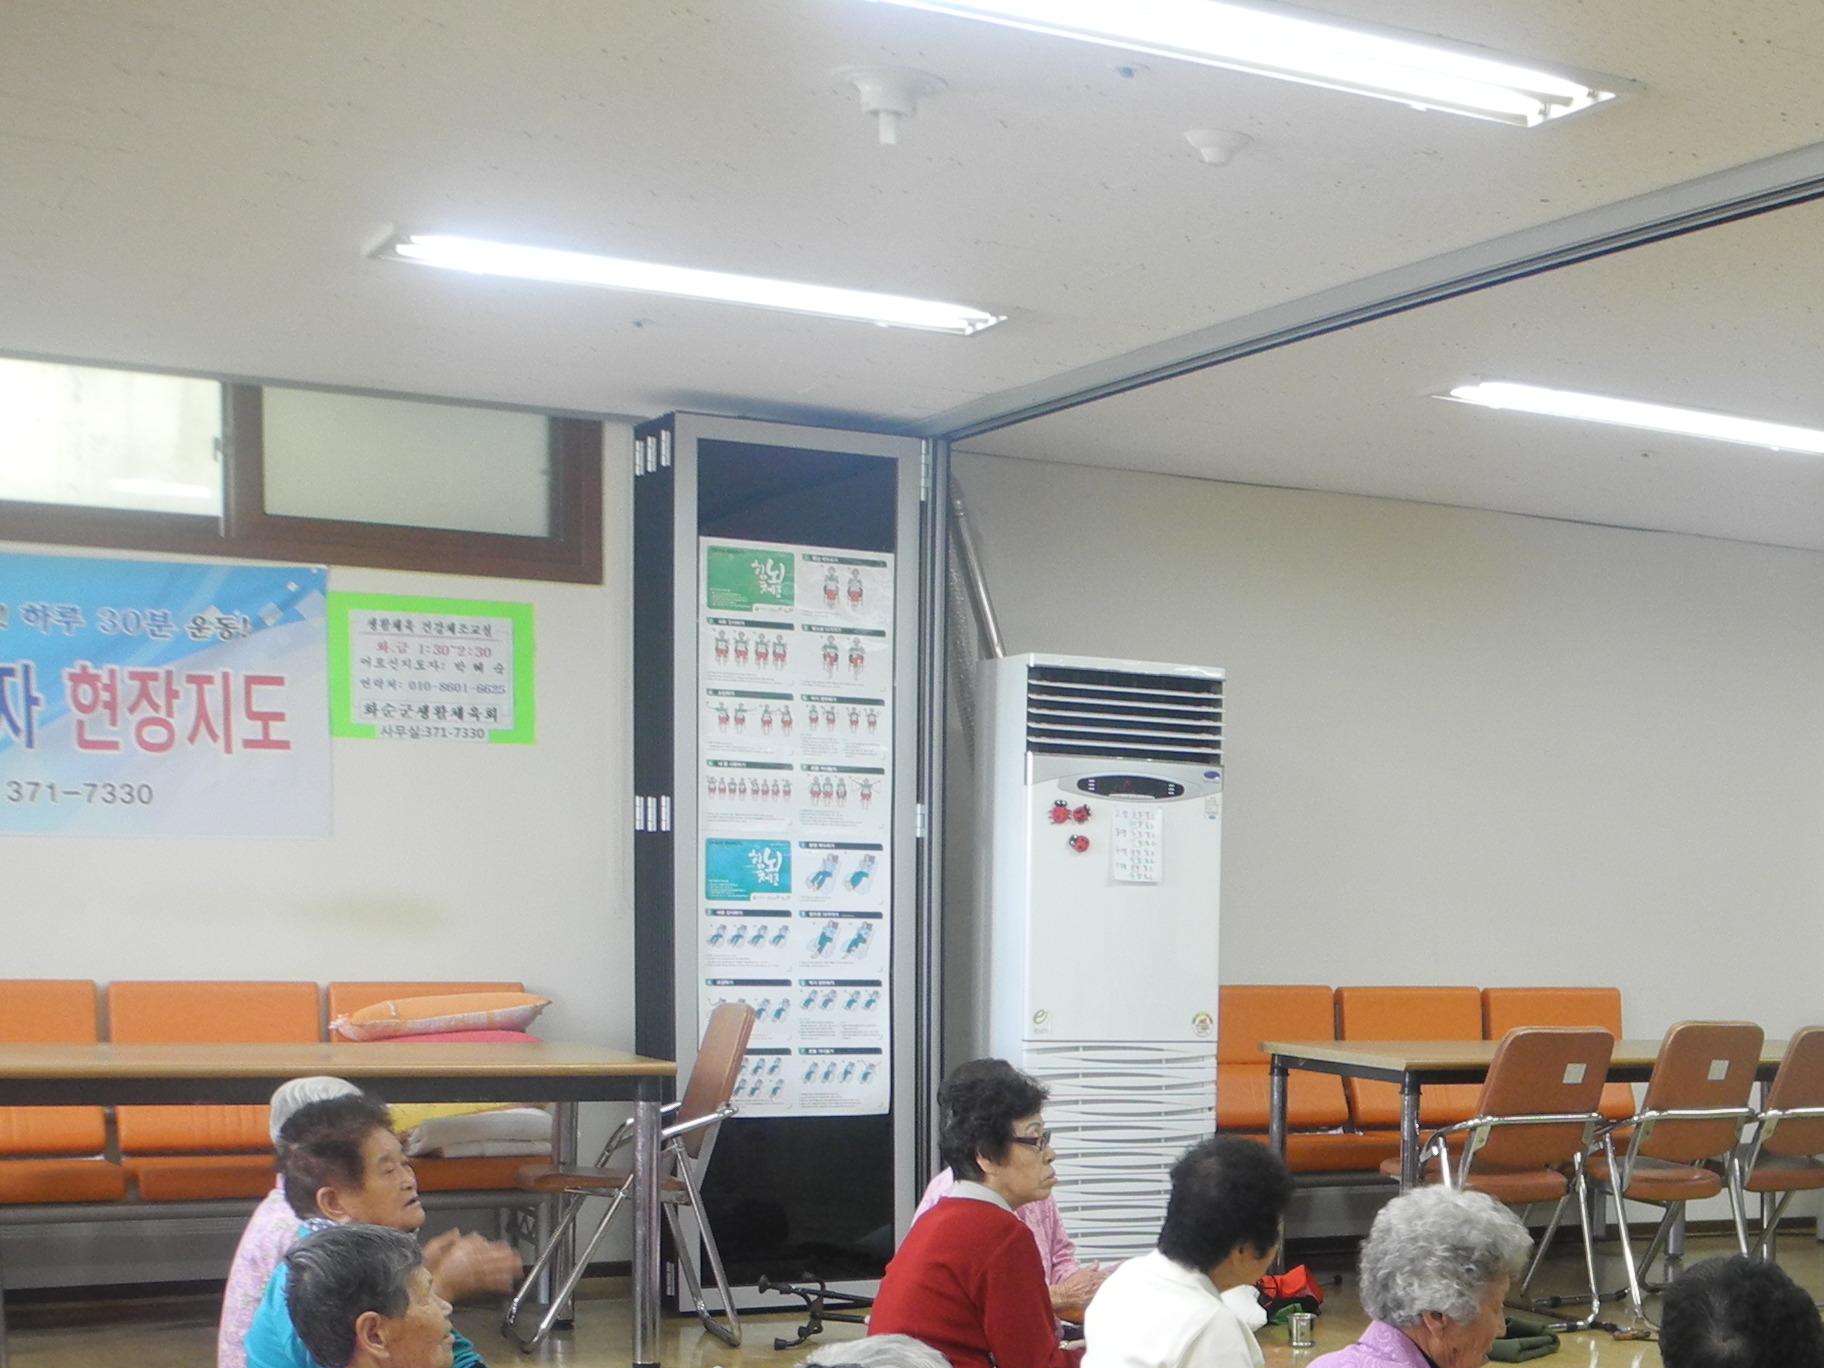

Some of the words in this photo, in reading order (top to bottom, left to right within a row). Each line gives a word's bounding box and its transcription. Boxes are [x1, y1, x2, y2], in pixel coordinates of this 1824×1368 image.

[22, 603, 84, 635] 하루
[97, 608, 176, 639] 30분
[187, 613, 250, 641] 운동!
[68, 664, 291, 754] 현장지도
[7, 780, 153, 804] 371-7330
